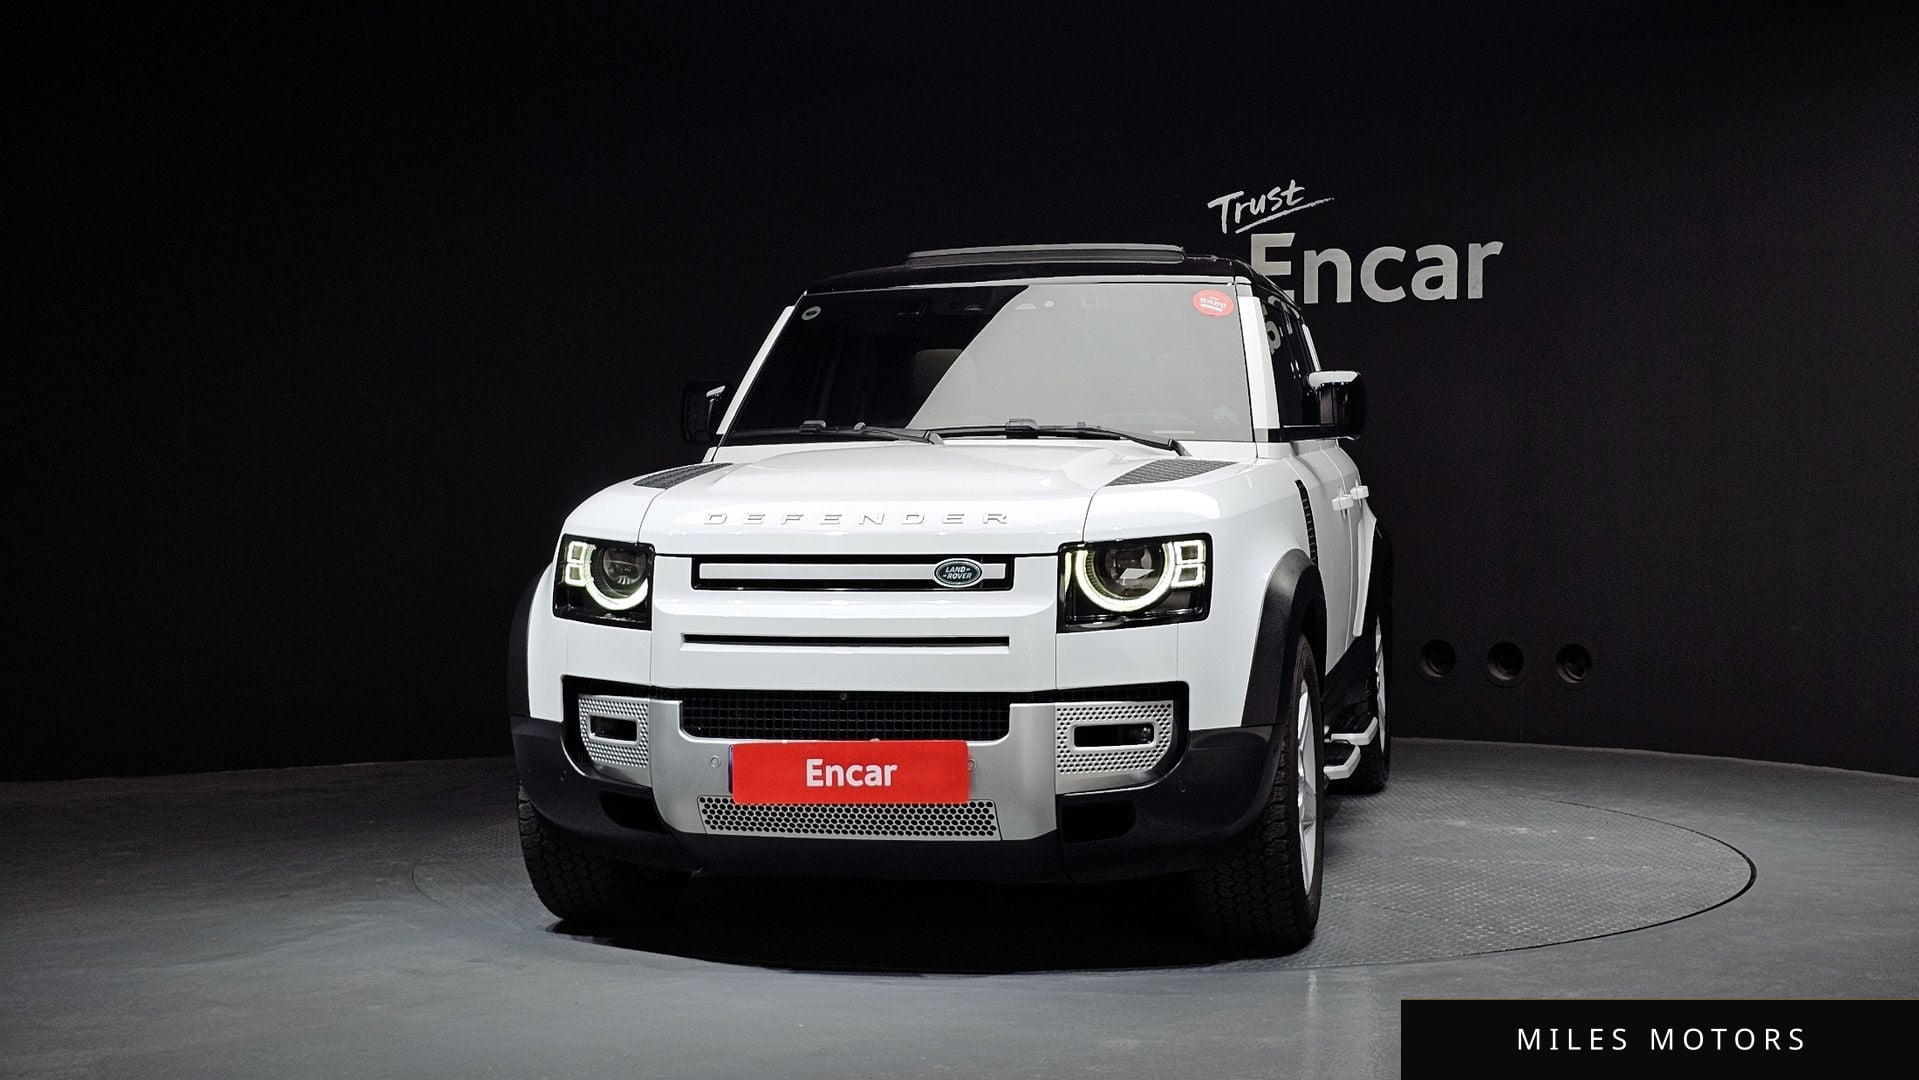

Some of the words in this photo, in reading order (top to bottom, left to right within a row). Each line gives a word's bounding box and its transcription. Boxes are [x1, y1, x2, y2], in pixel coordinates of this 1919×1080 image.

[1207, 179, 1306, 234] Trust
[1250, 232, 1504, 305] Encar
[703, 512, 1008, 525] DEFENDER
[806, 758, 898, 787] Encar
